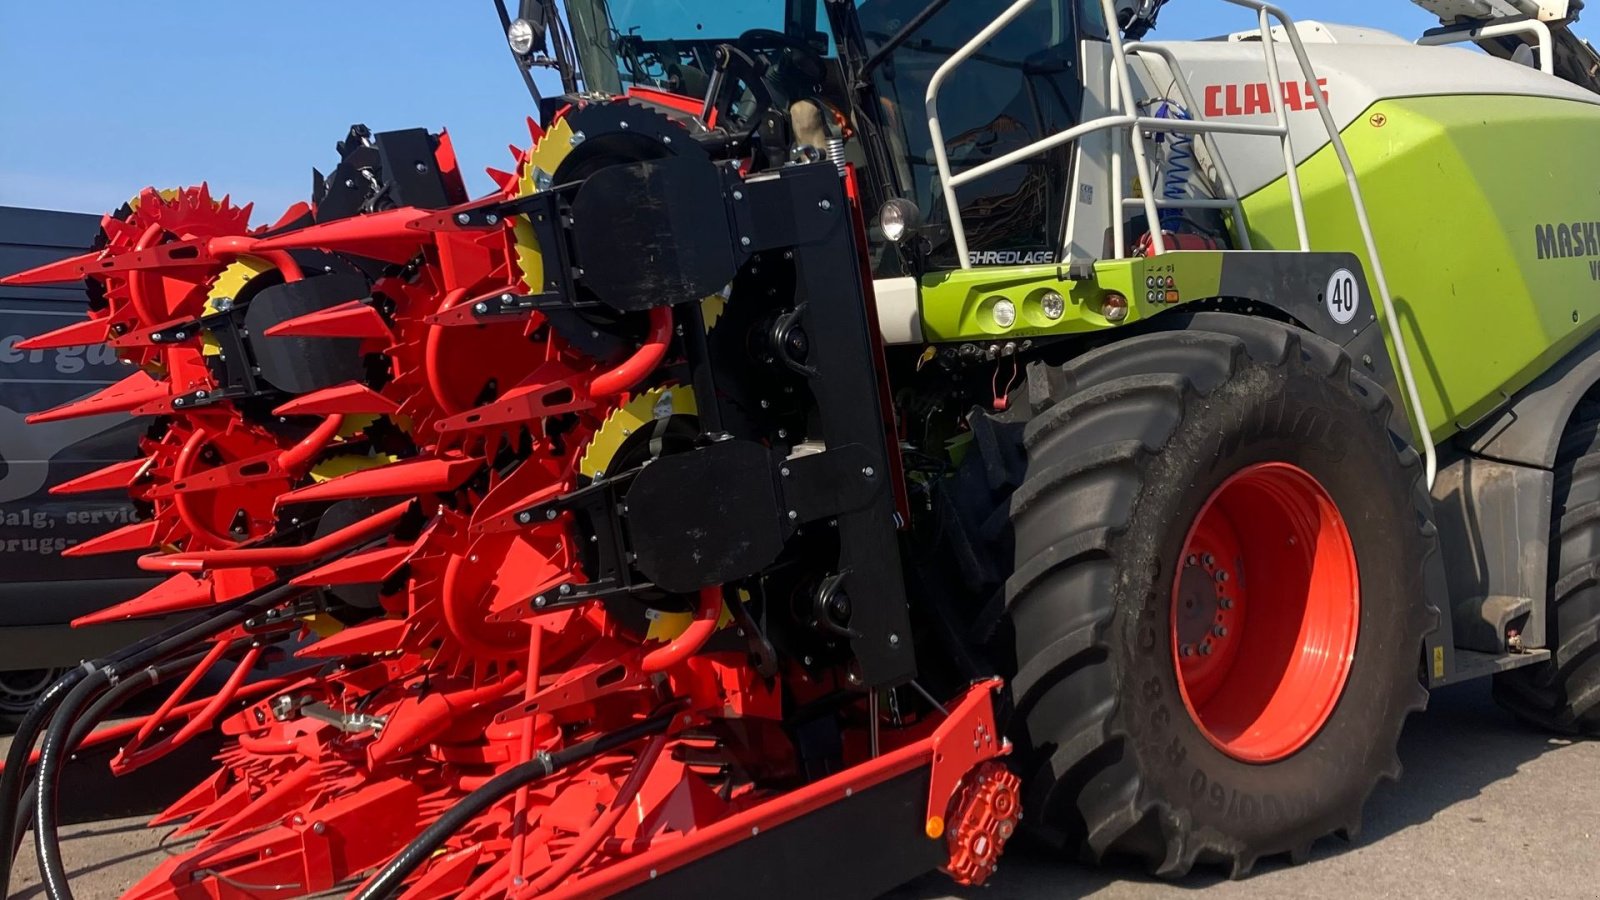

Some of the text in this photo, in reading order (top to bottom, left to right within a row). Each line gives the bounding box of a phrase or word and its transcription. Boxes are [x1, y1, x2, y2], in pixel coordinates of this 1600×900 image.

[1204, 78, 1329, 117] CLAAS
[968, 251, 1053, 264] SHREDLAGE
[1332, 277, 1353, 312] 40
